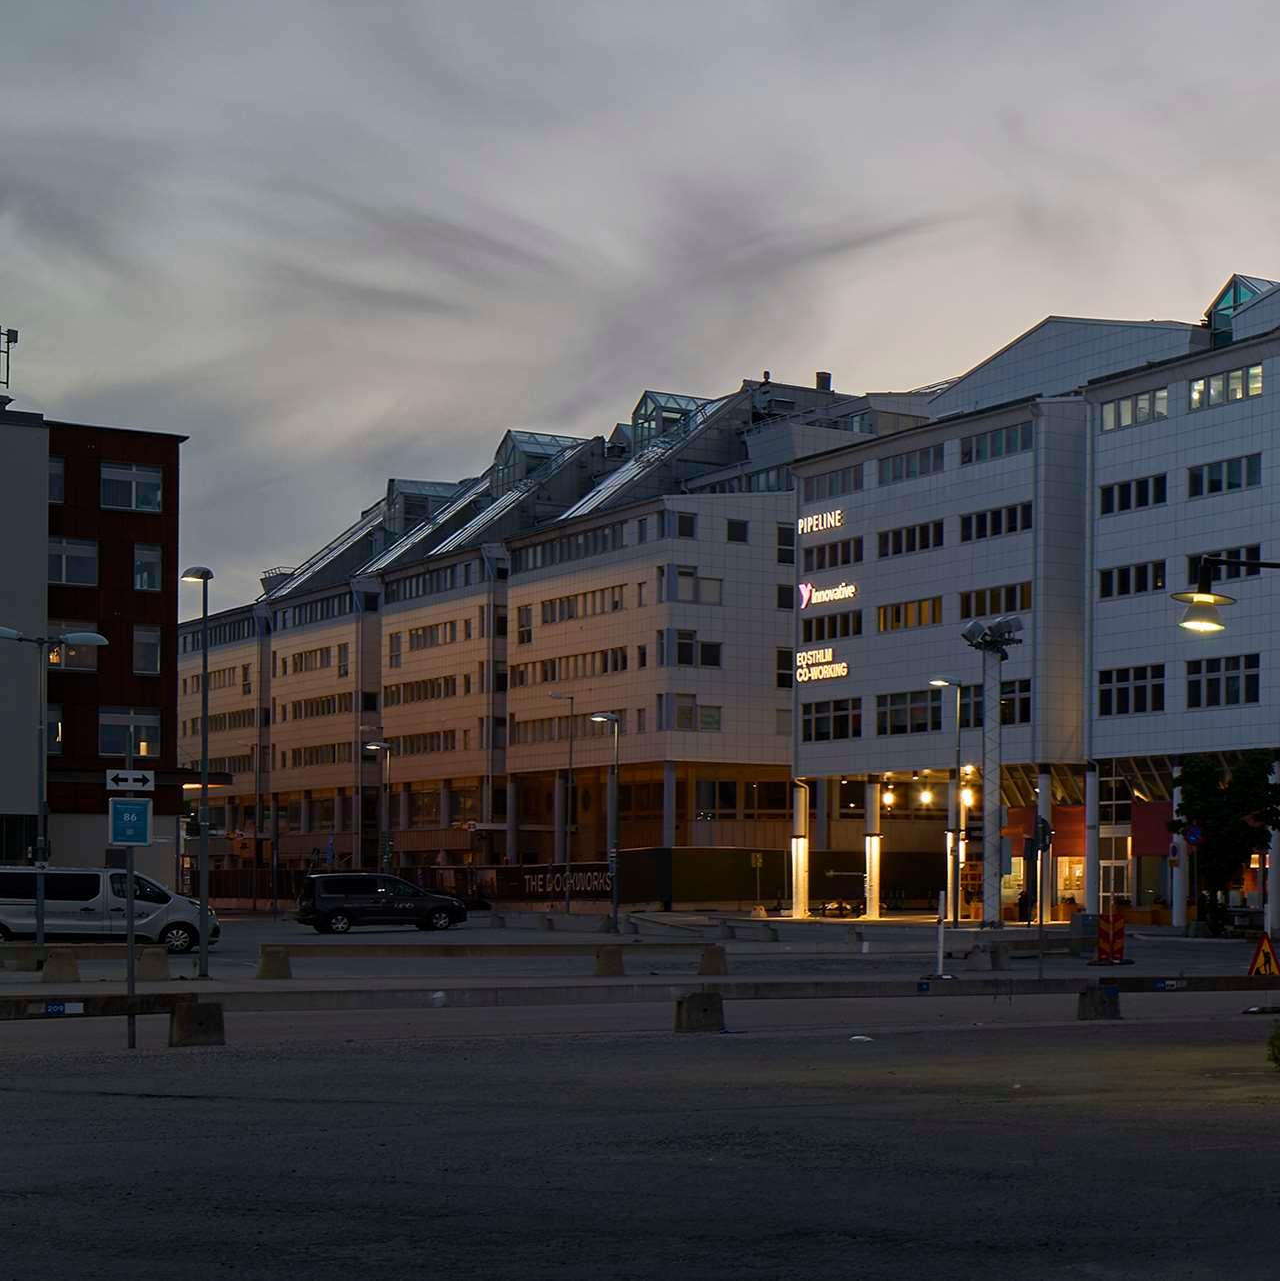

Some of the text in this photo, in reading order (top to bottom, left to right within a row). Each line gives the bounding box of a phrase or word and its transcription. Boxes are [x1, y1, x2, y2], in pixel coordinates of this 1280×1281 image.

[798, 510, 842, 535] PIPELINE
[811, 582, 856, 604] Innovative
[524, 874, 544, 893] THE
